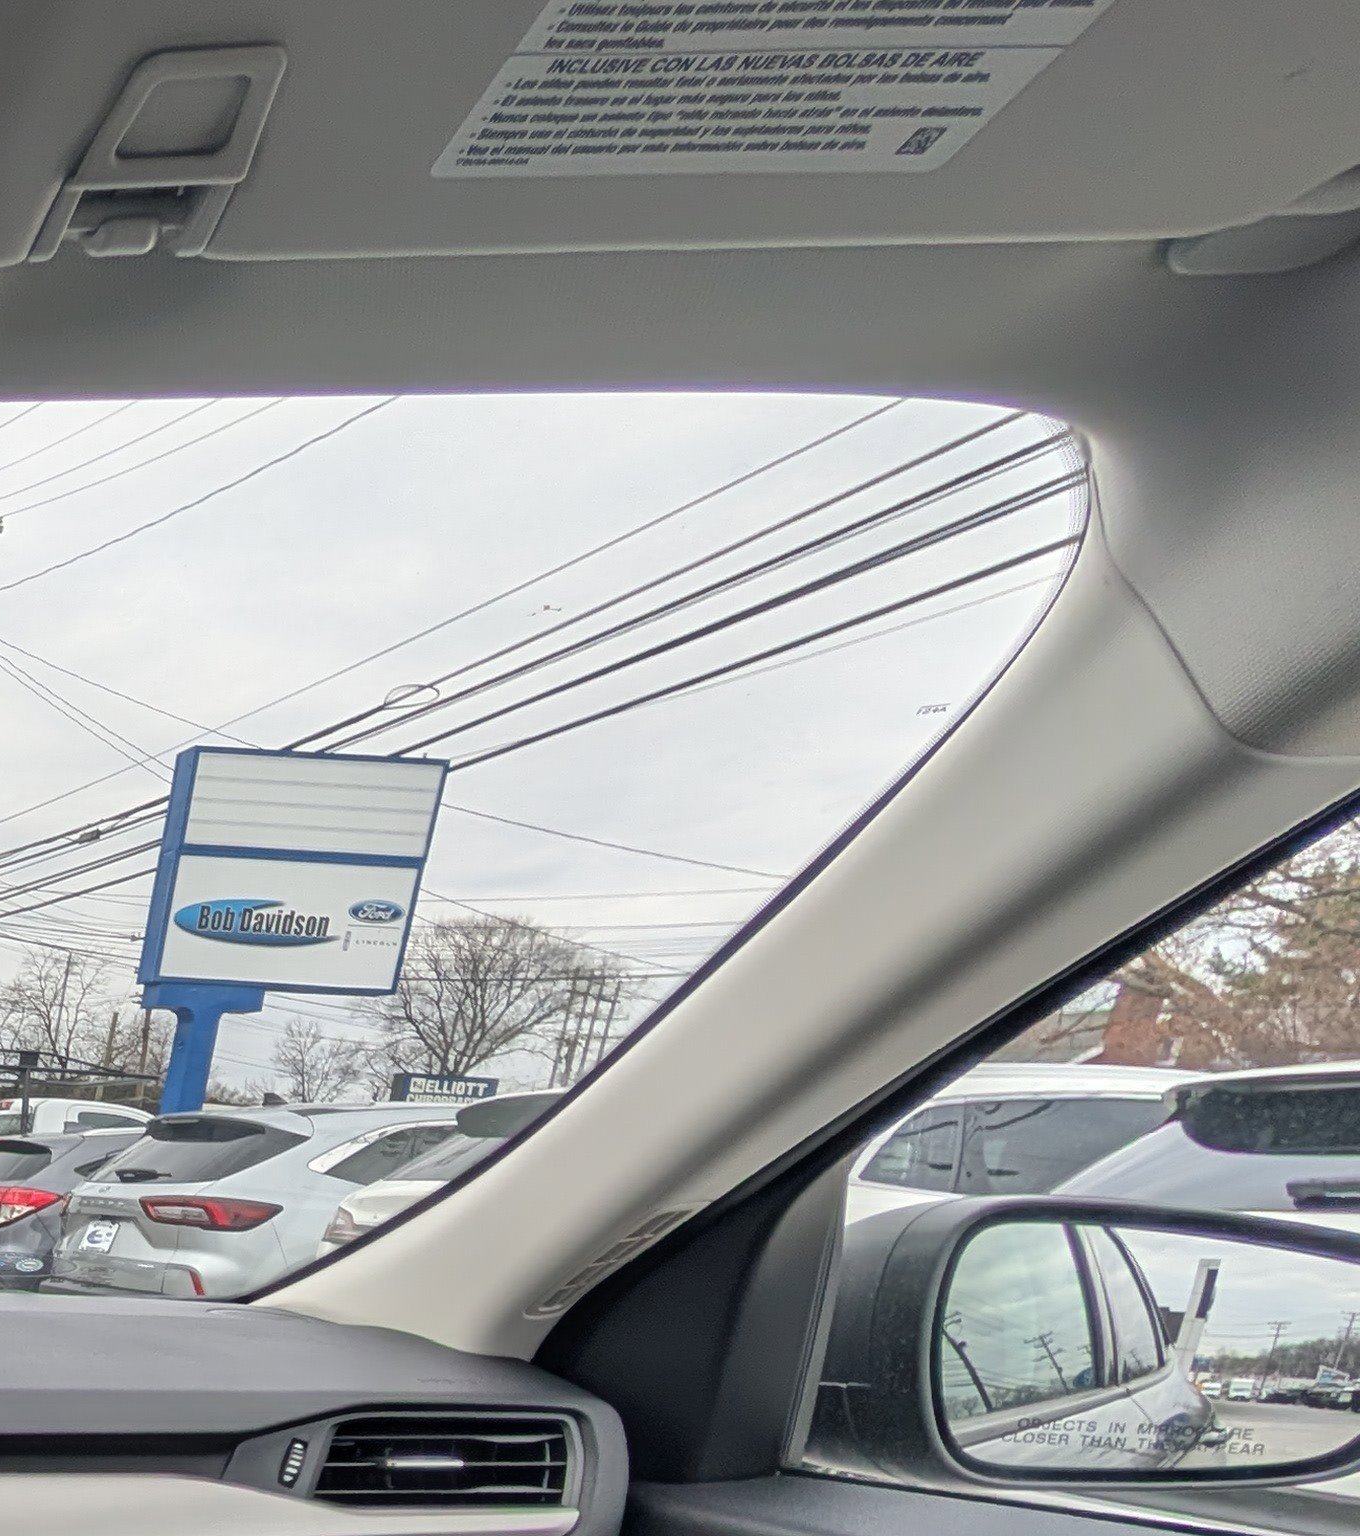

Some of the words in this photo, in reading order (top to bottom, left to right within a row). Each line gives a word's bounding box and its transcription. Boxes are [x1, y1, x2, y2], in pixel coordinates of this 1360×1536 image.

[547, 57, 649, 74] INCLUSIVE
[651, 56, 694, 72] CON
[697, 55, 736, 71] LAS
[739, 53, 817, 70] NUEVAS
[819, 51, 901, 69] BOLSAS
[902, 52, 931, 67] DE
[932, 51, 982, 67] AIRE
[358, 903, 395, 920] Ford
[197, 905, 233, 932] Bob
[239, 909, 330, 937] Davidson
[426, 1079, 488, 1096] ELLIOTT
[406, 1093, 481, 1104] CHIROPRAC
[1017, 1417, 1098, 1433] OBJECTS
[1108, 1420, 1127, 1434] IN
[1001, 1431, 1070, 1447] CLOSER
[1080, 1434, 1128, 1449] THAN
